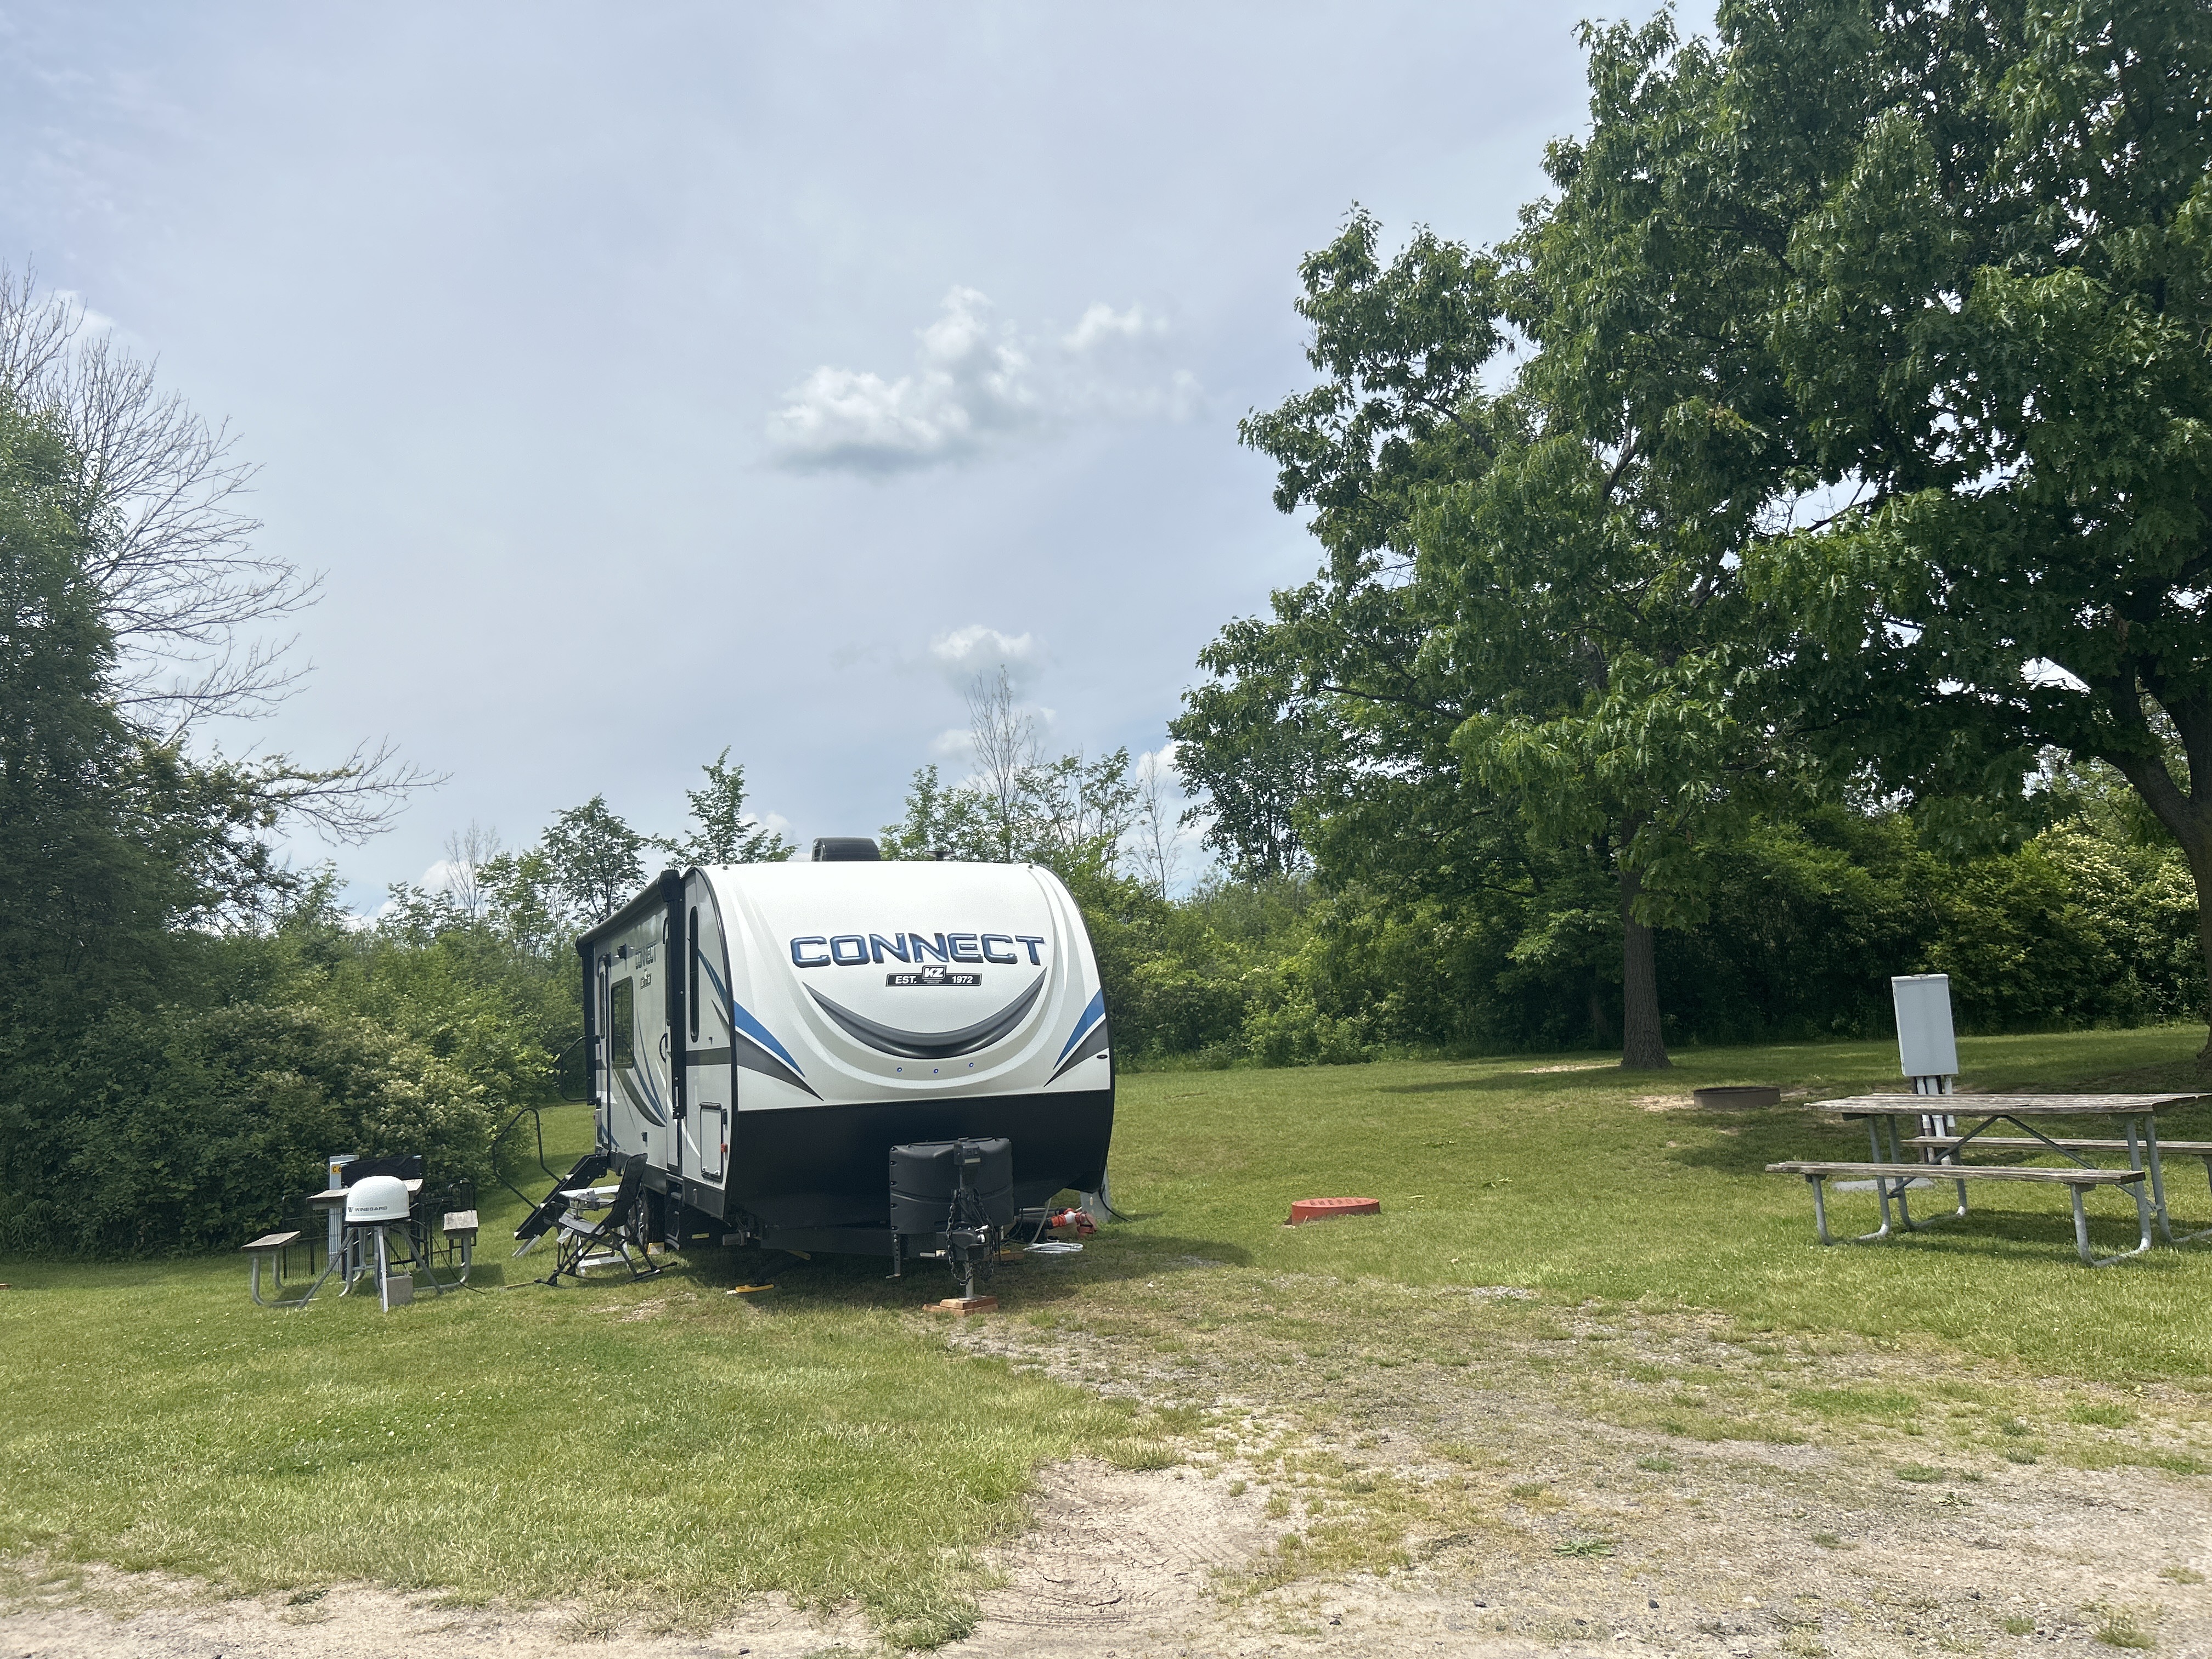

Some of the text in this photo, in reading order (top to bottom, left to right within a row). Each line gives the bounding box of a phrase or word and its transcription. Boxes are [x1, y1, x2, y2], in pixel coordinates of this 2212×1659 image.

[790, 933, 1045, 968] CONNECT
[895, 976, 917, 984] EST.
[924, 967, 944, 978] KZ
[952, 975, 973, 984] 1972
